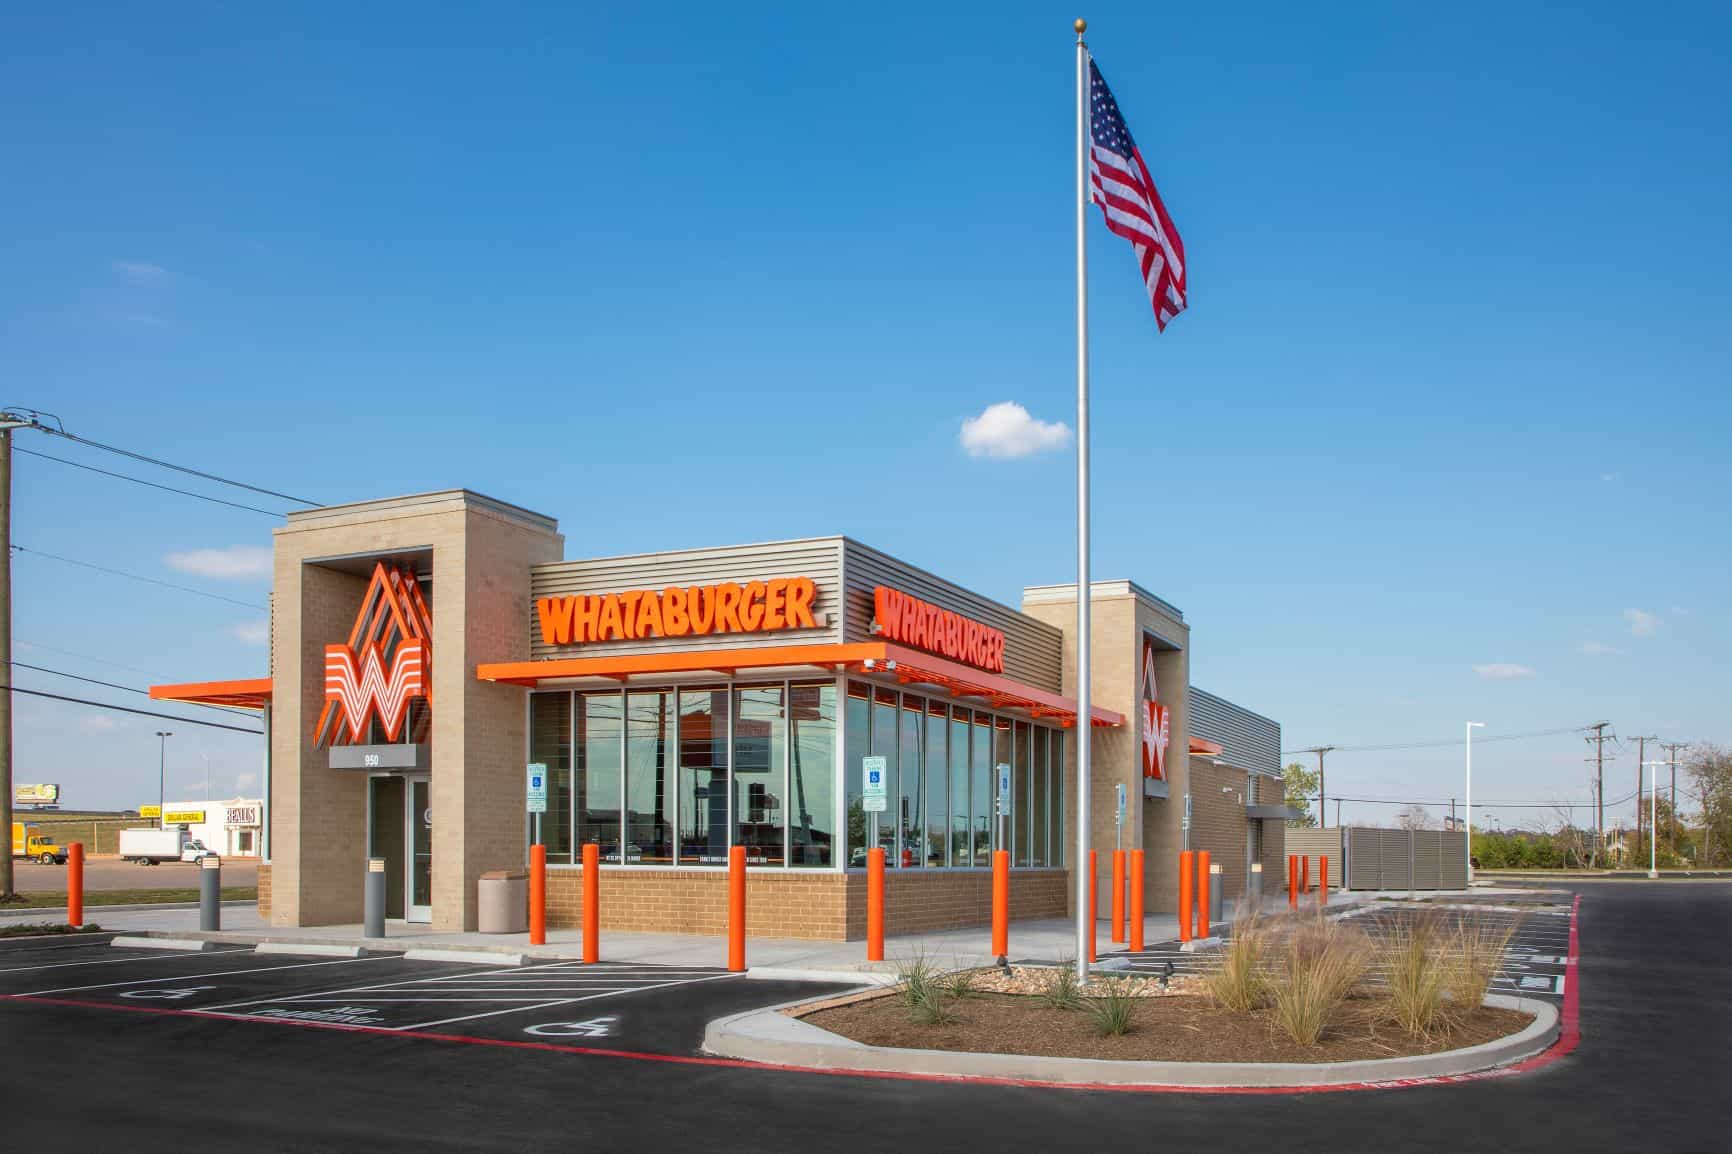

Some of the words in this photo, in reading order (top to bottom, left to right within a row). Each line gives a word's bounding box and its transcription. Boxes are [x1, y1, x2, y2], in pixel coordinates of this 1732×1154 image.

[536, 575, 817, 646] WHATABURGER
[874, 585, 1005, 674] WHATABURGER
[364, 754, 379, 766] 950
